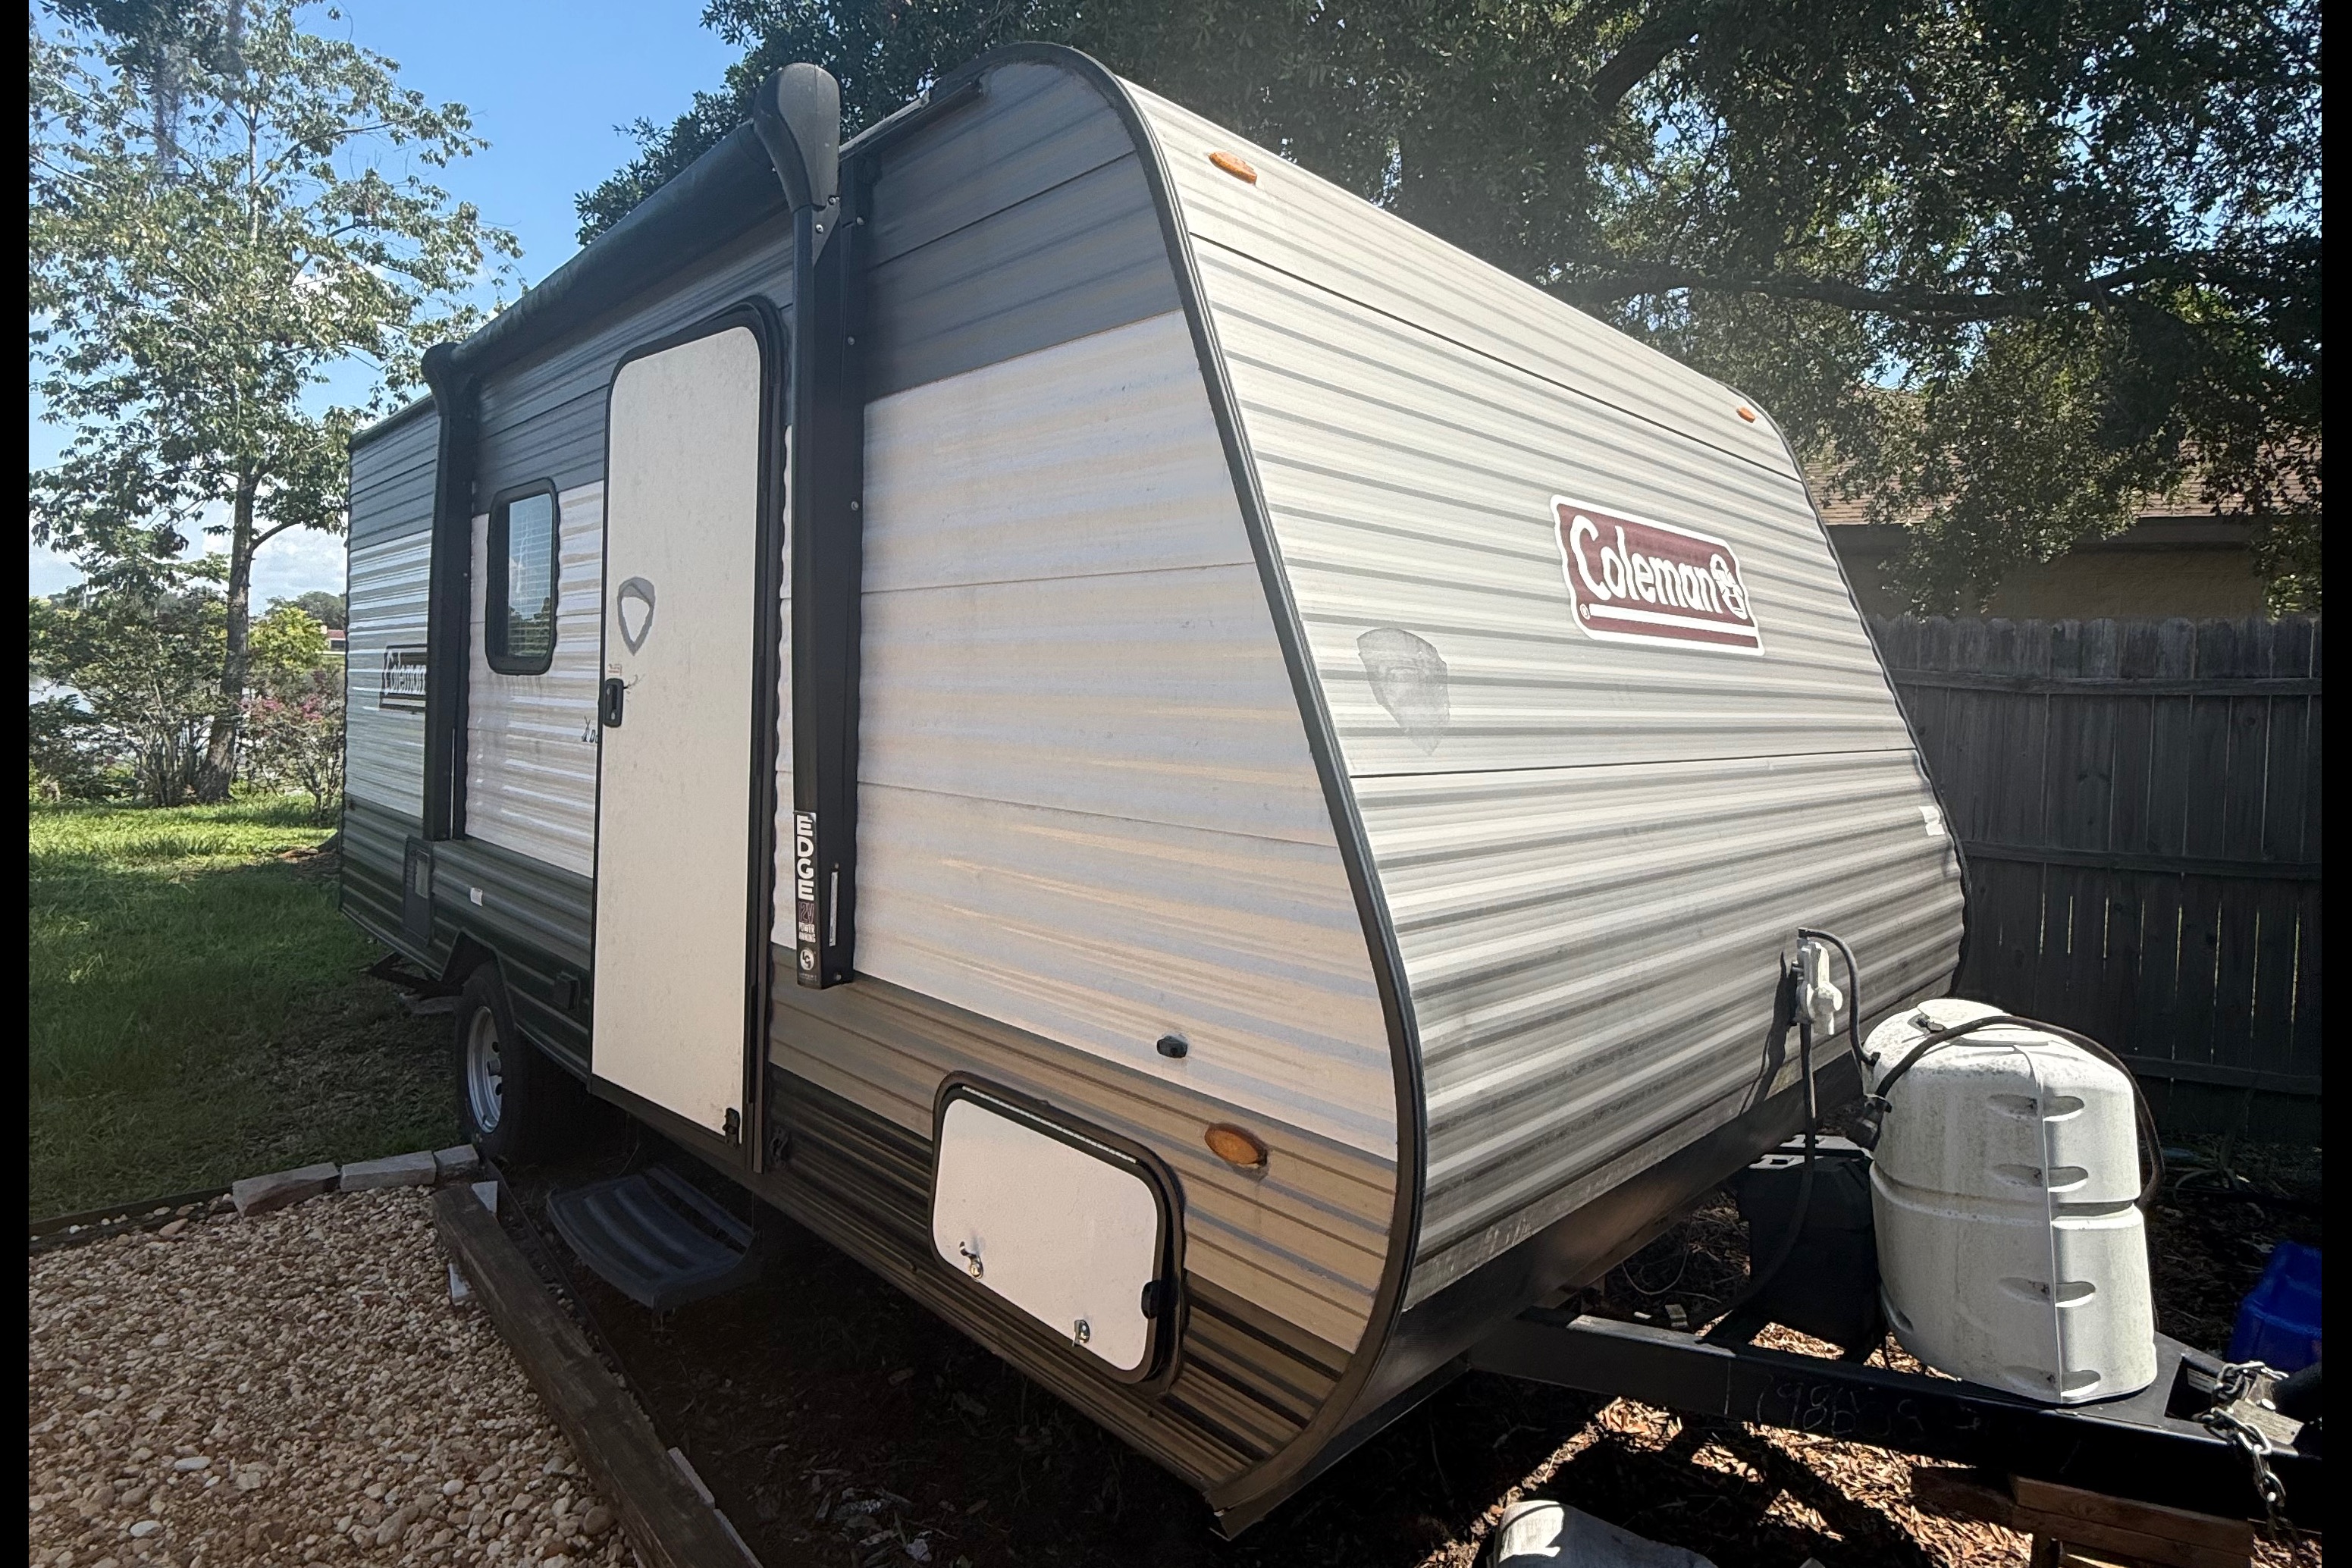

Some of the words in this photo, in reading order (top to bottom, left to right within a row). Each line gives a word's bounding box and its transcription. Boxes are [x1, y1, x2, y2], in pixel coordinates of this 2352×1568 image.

[1570, 513, 1723, 614] Coleman
[385, 649, 427, 695] Coleman
[796, 814, 814, 902] EDGE
[798, 901, 815, 924] 12V
